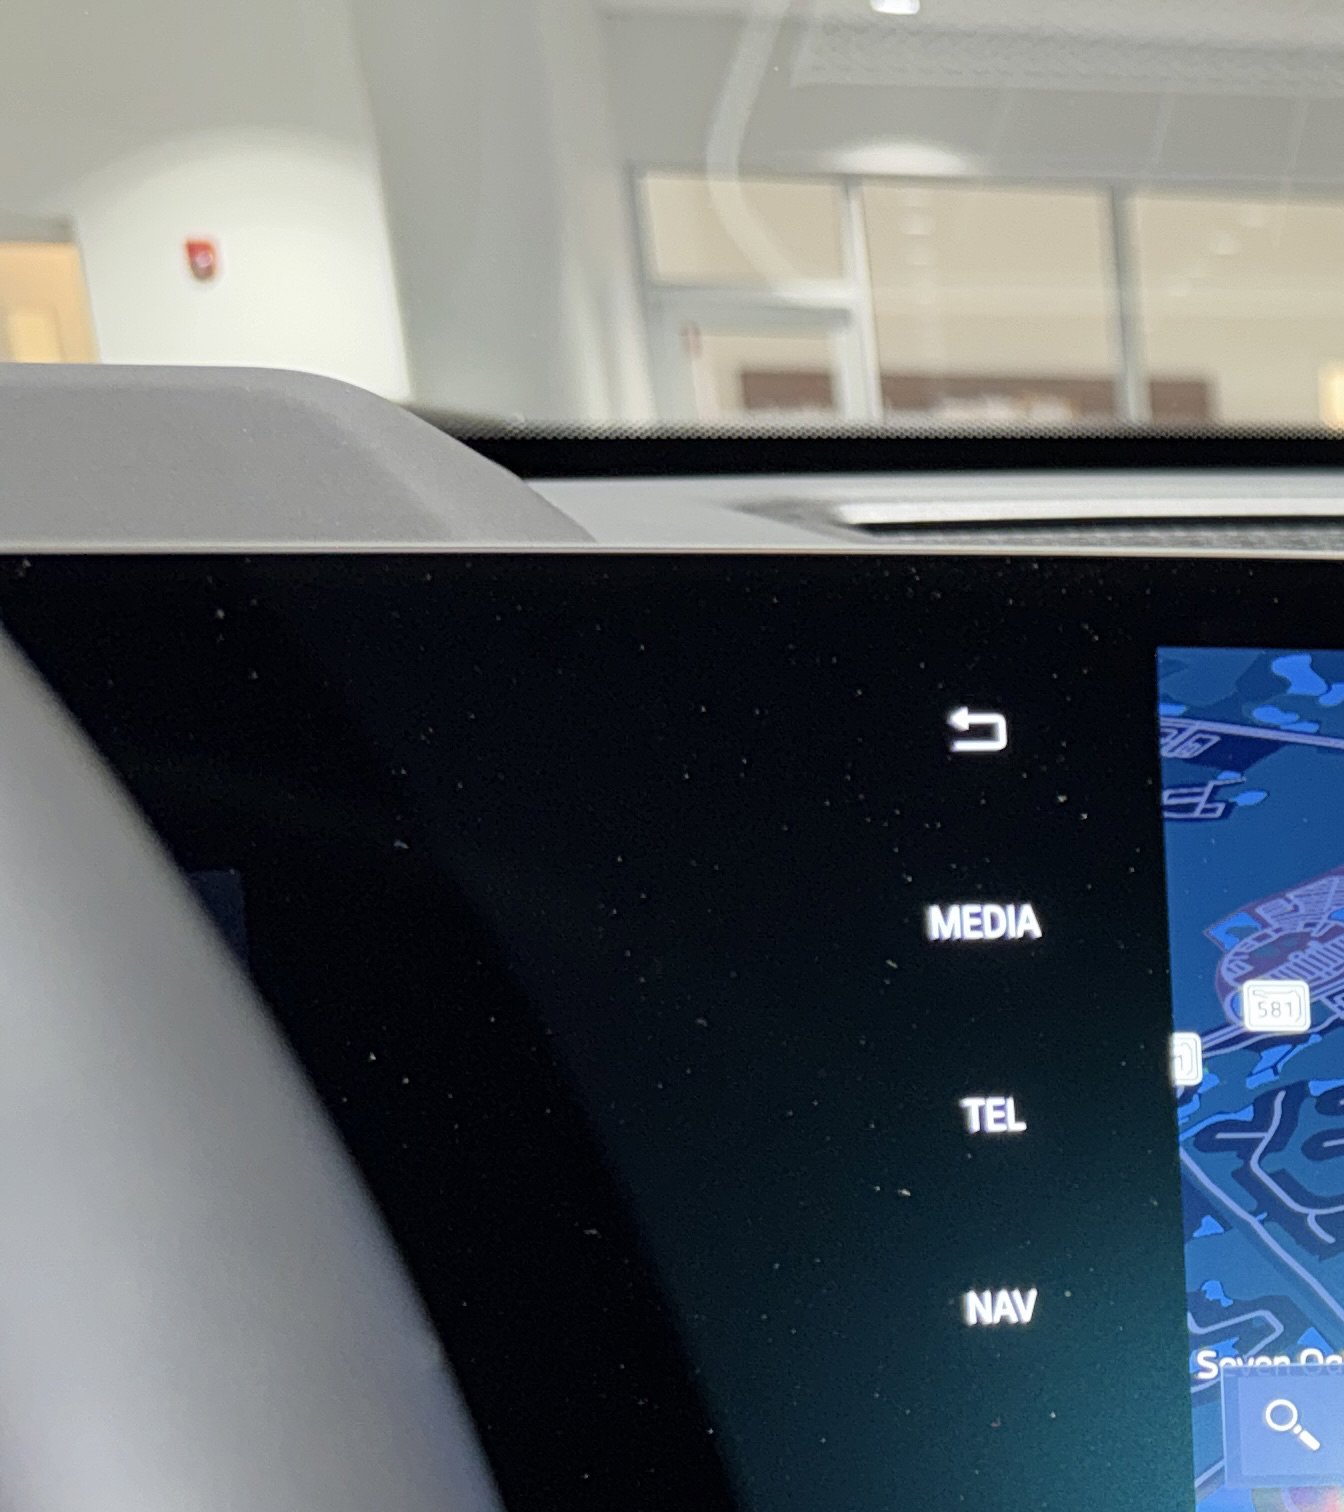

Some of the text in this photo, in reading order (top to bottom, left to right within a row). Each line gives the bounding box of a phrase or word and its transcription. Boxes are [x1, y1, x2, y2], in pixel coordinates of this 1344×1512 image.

[927, 903, 1043, 941] MEDIA
[1257, 1001, 1293, 1018] 581
[960, 1096, 1028, 1134] TEL
[963, 1288, 1038, 1326] NAV
